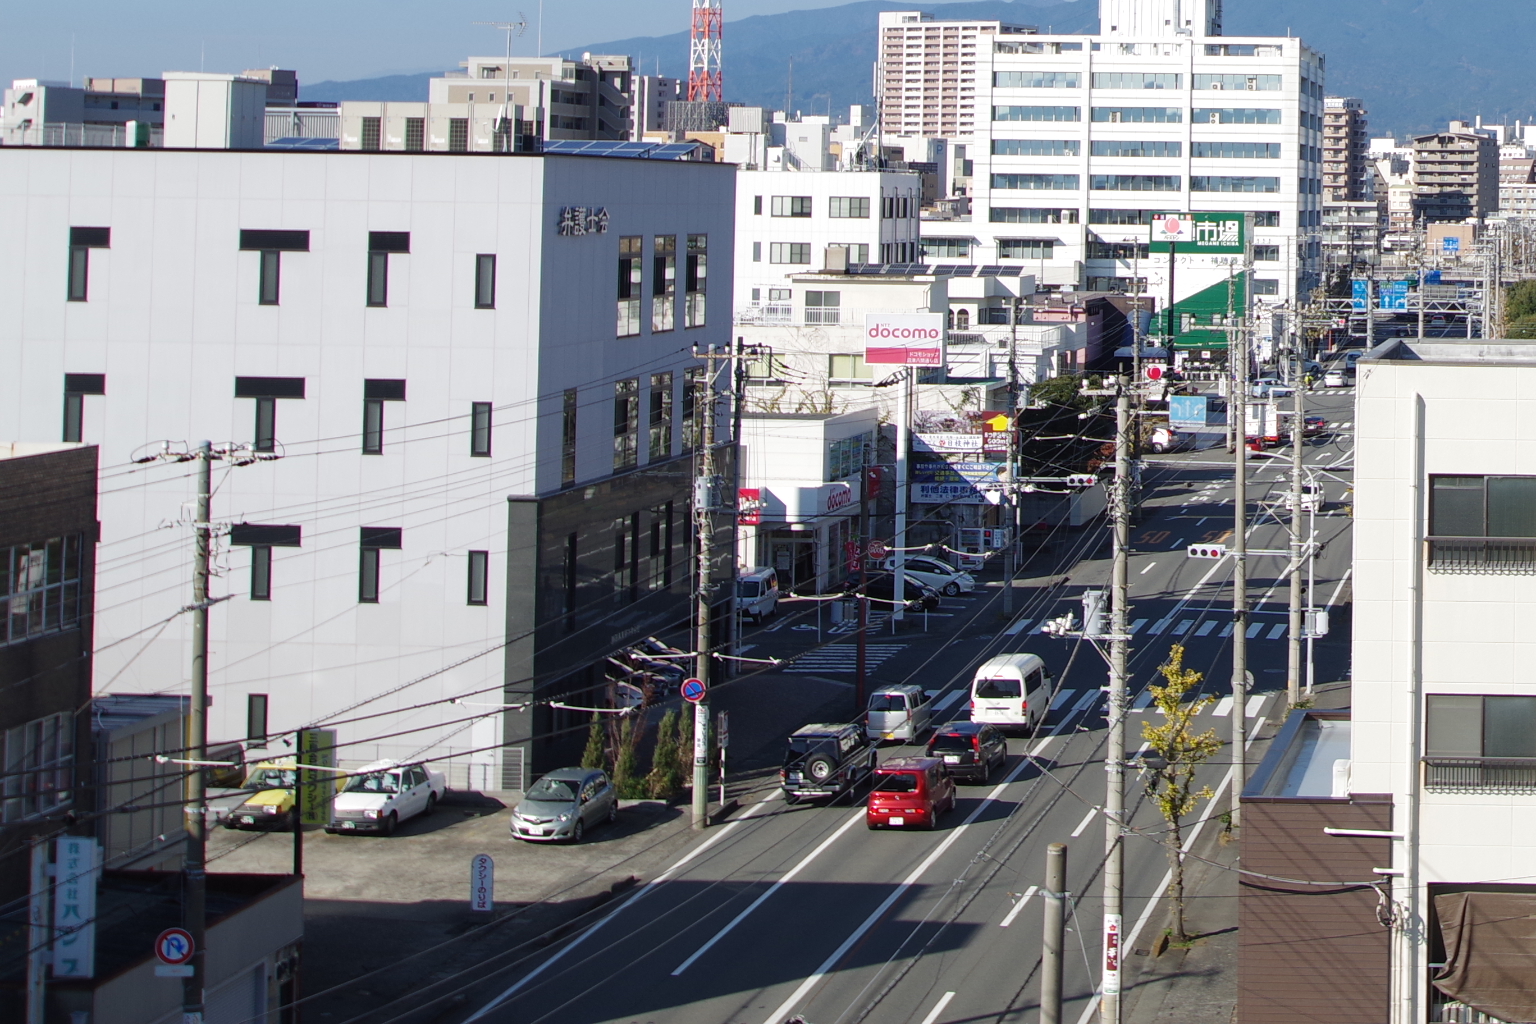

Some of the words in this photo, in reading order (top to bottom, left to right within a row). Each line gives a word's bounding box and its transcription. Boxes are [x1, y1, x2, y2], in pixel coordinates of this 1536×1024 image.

[936, 144, 944, 155] P
[561, 206, 610, 236] 弁護士会
[1192, 220, 1239, 241] 市場
[868, 323, 939, 339] docomo
[827, 488, 851, 510] docomo
[1133, 531, 1171, 544] 50
[477, 857, 487, 908] タクシーのりば
